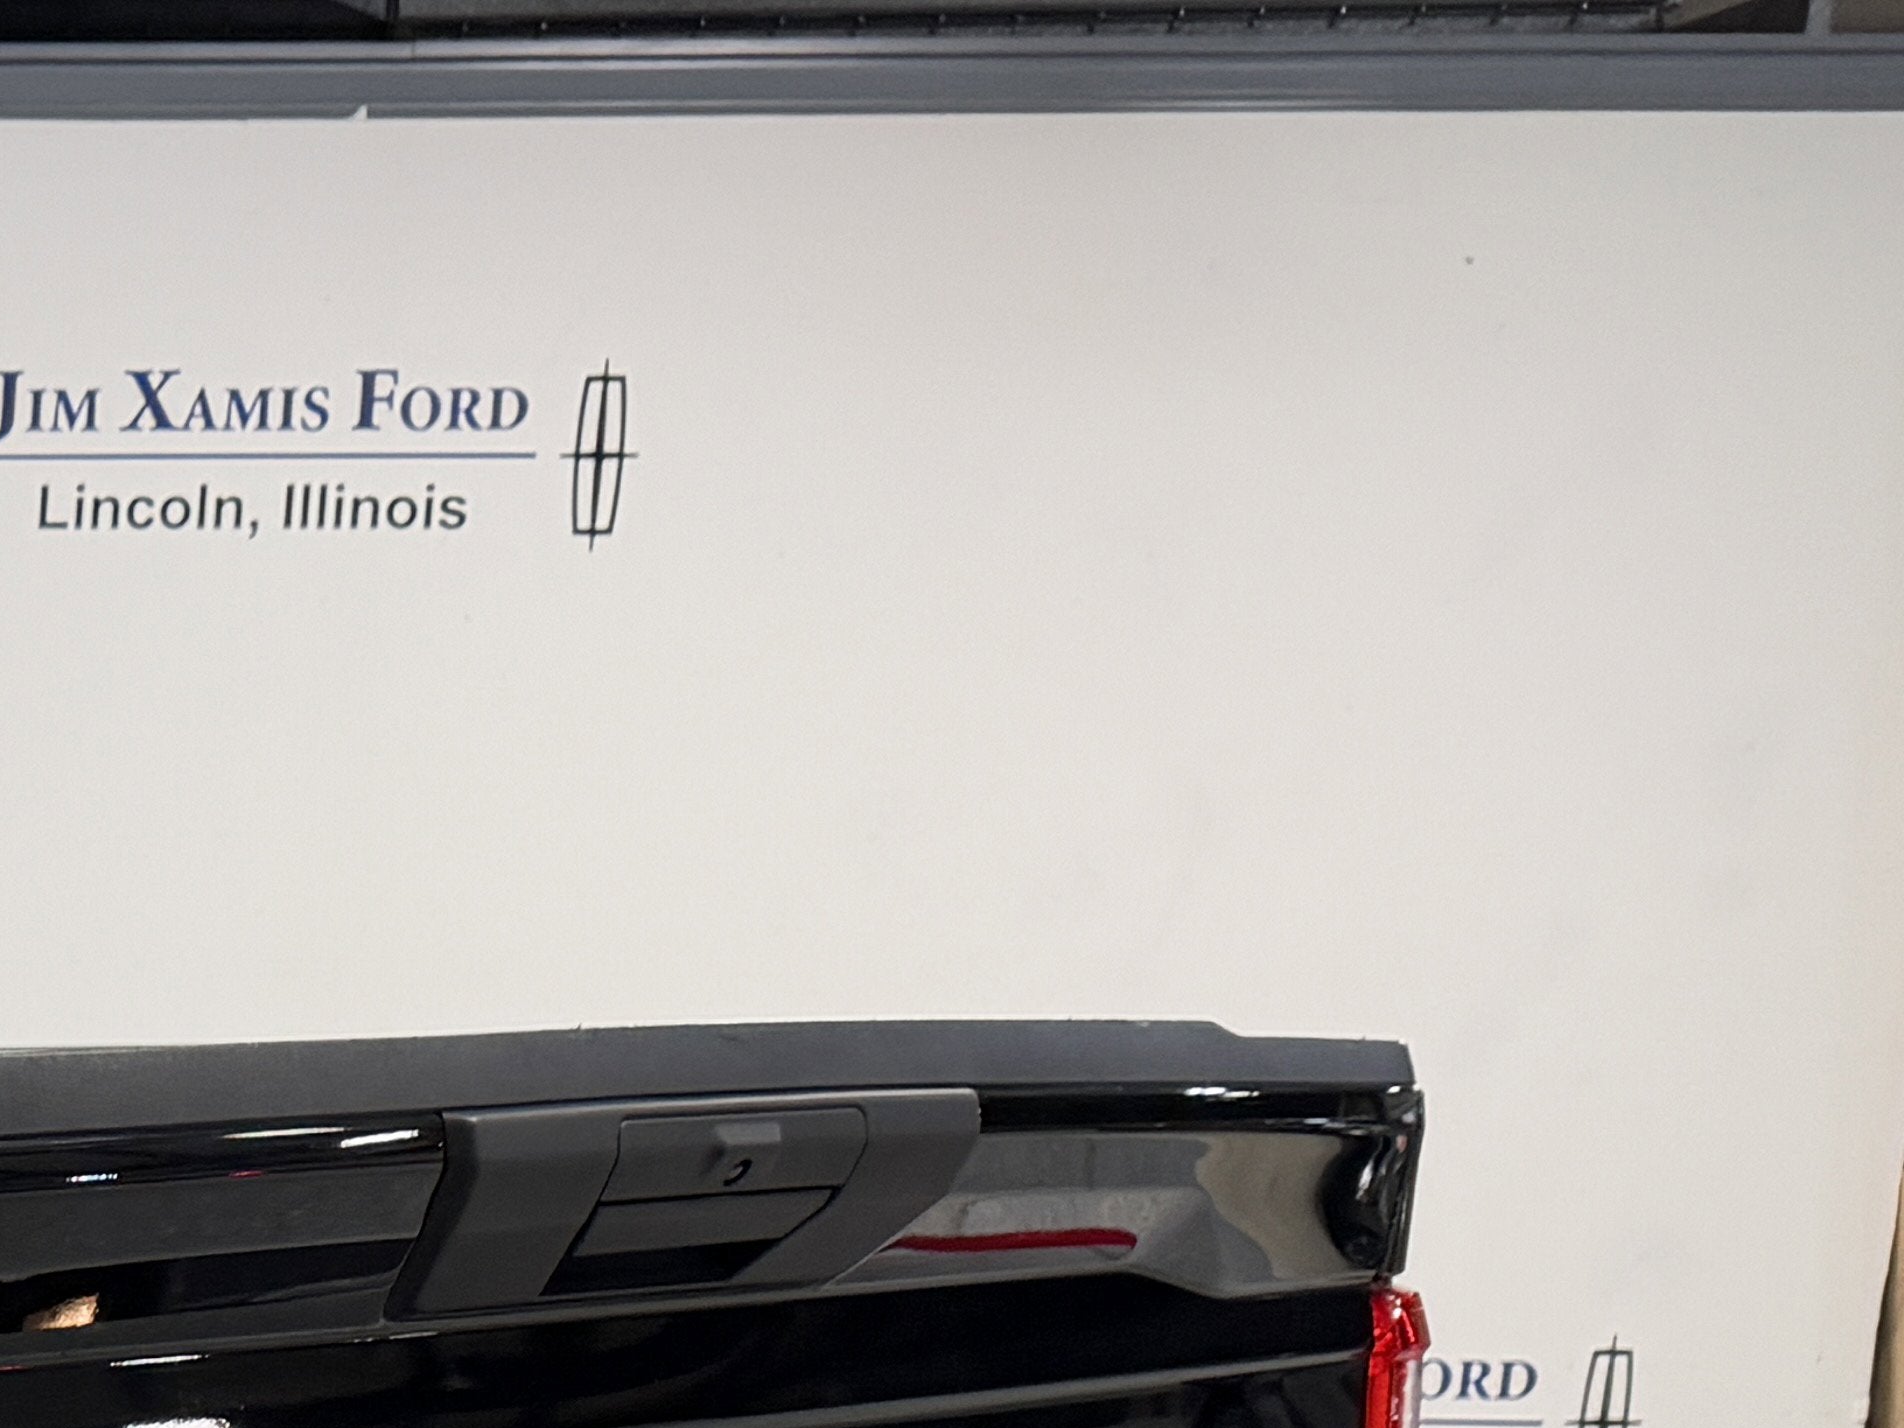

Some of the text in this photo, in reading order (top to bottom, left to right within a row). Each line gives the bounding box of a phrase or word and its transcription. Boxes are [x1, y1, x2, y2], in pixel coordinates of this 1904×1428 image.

[119, 367, 330, 432] XAMIS
[354, 368, 530, 432] FORD
[37, 482, 469, 539] Lincoln, Illinois
